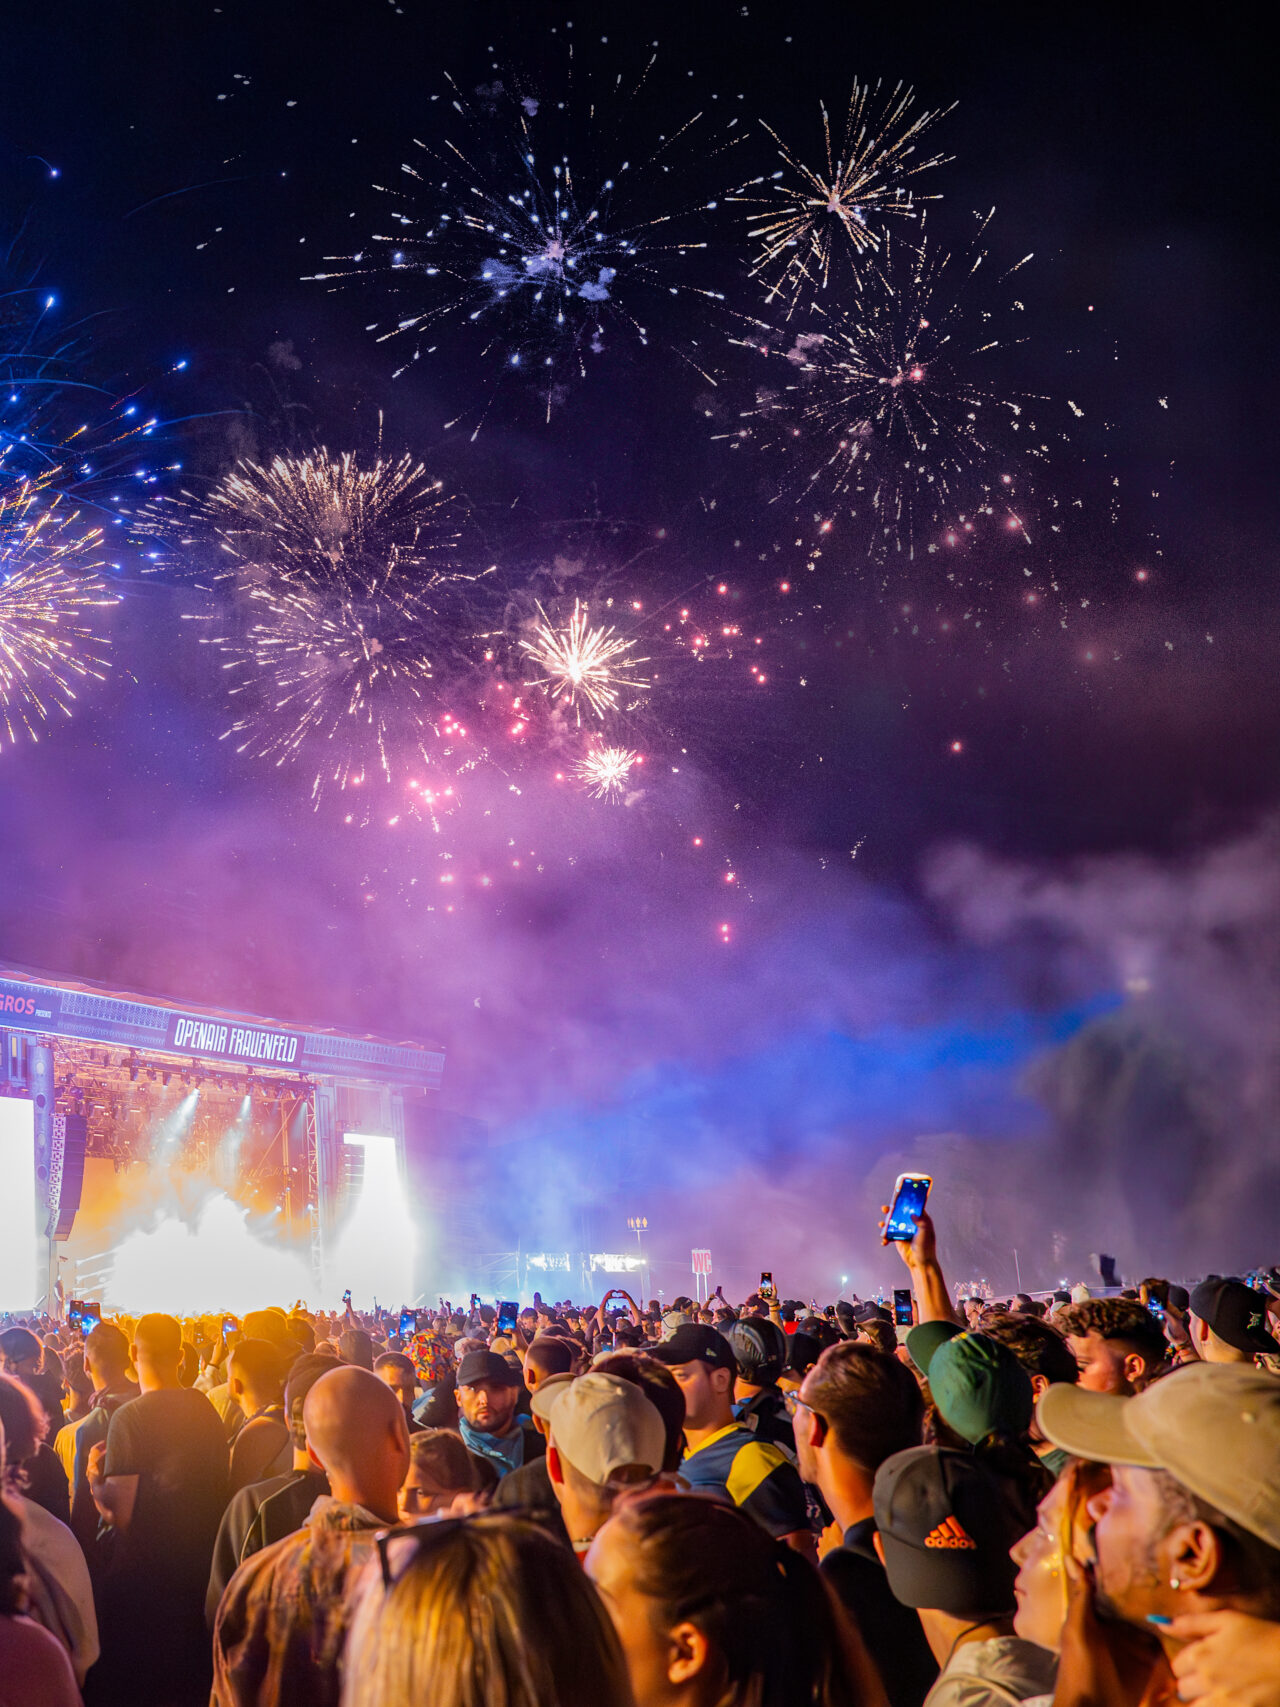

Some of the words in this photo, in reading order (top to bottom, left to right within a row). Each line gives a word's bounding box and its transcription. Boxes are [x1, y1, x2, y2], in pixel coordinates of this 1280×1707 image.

[174, 1018, 228, 1053] OPENAIR
[228, 1027, 298, 1063] FRAUENFELD
[692, 1252, 712, 1273] WC
[924, 1535, 977, 1550] adidas
